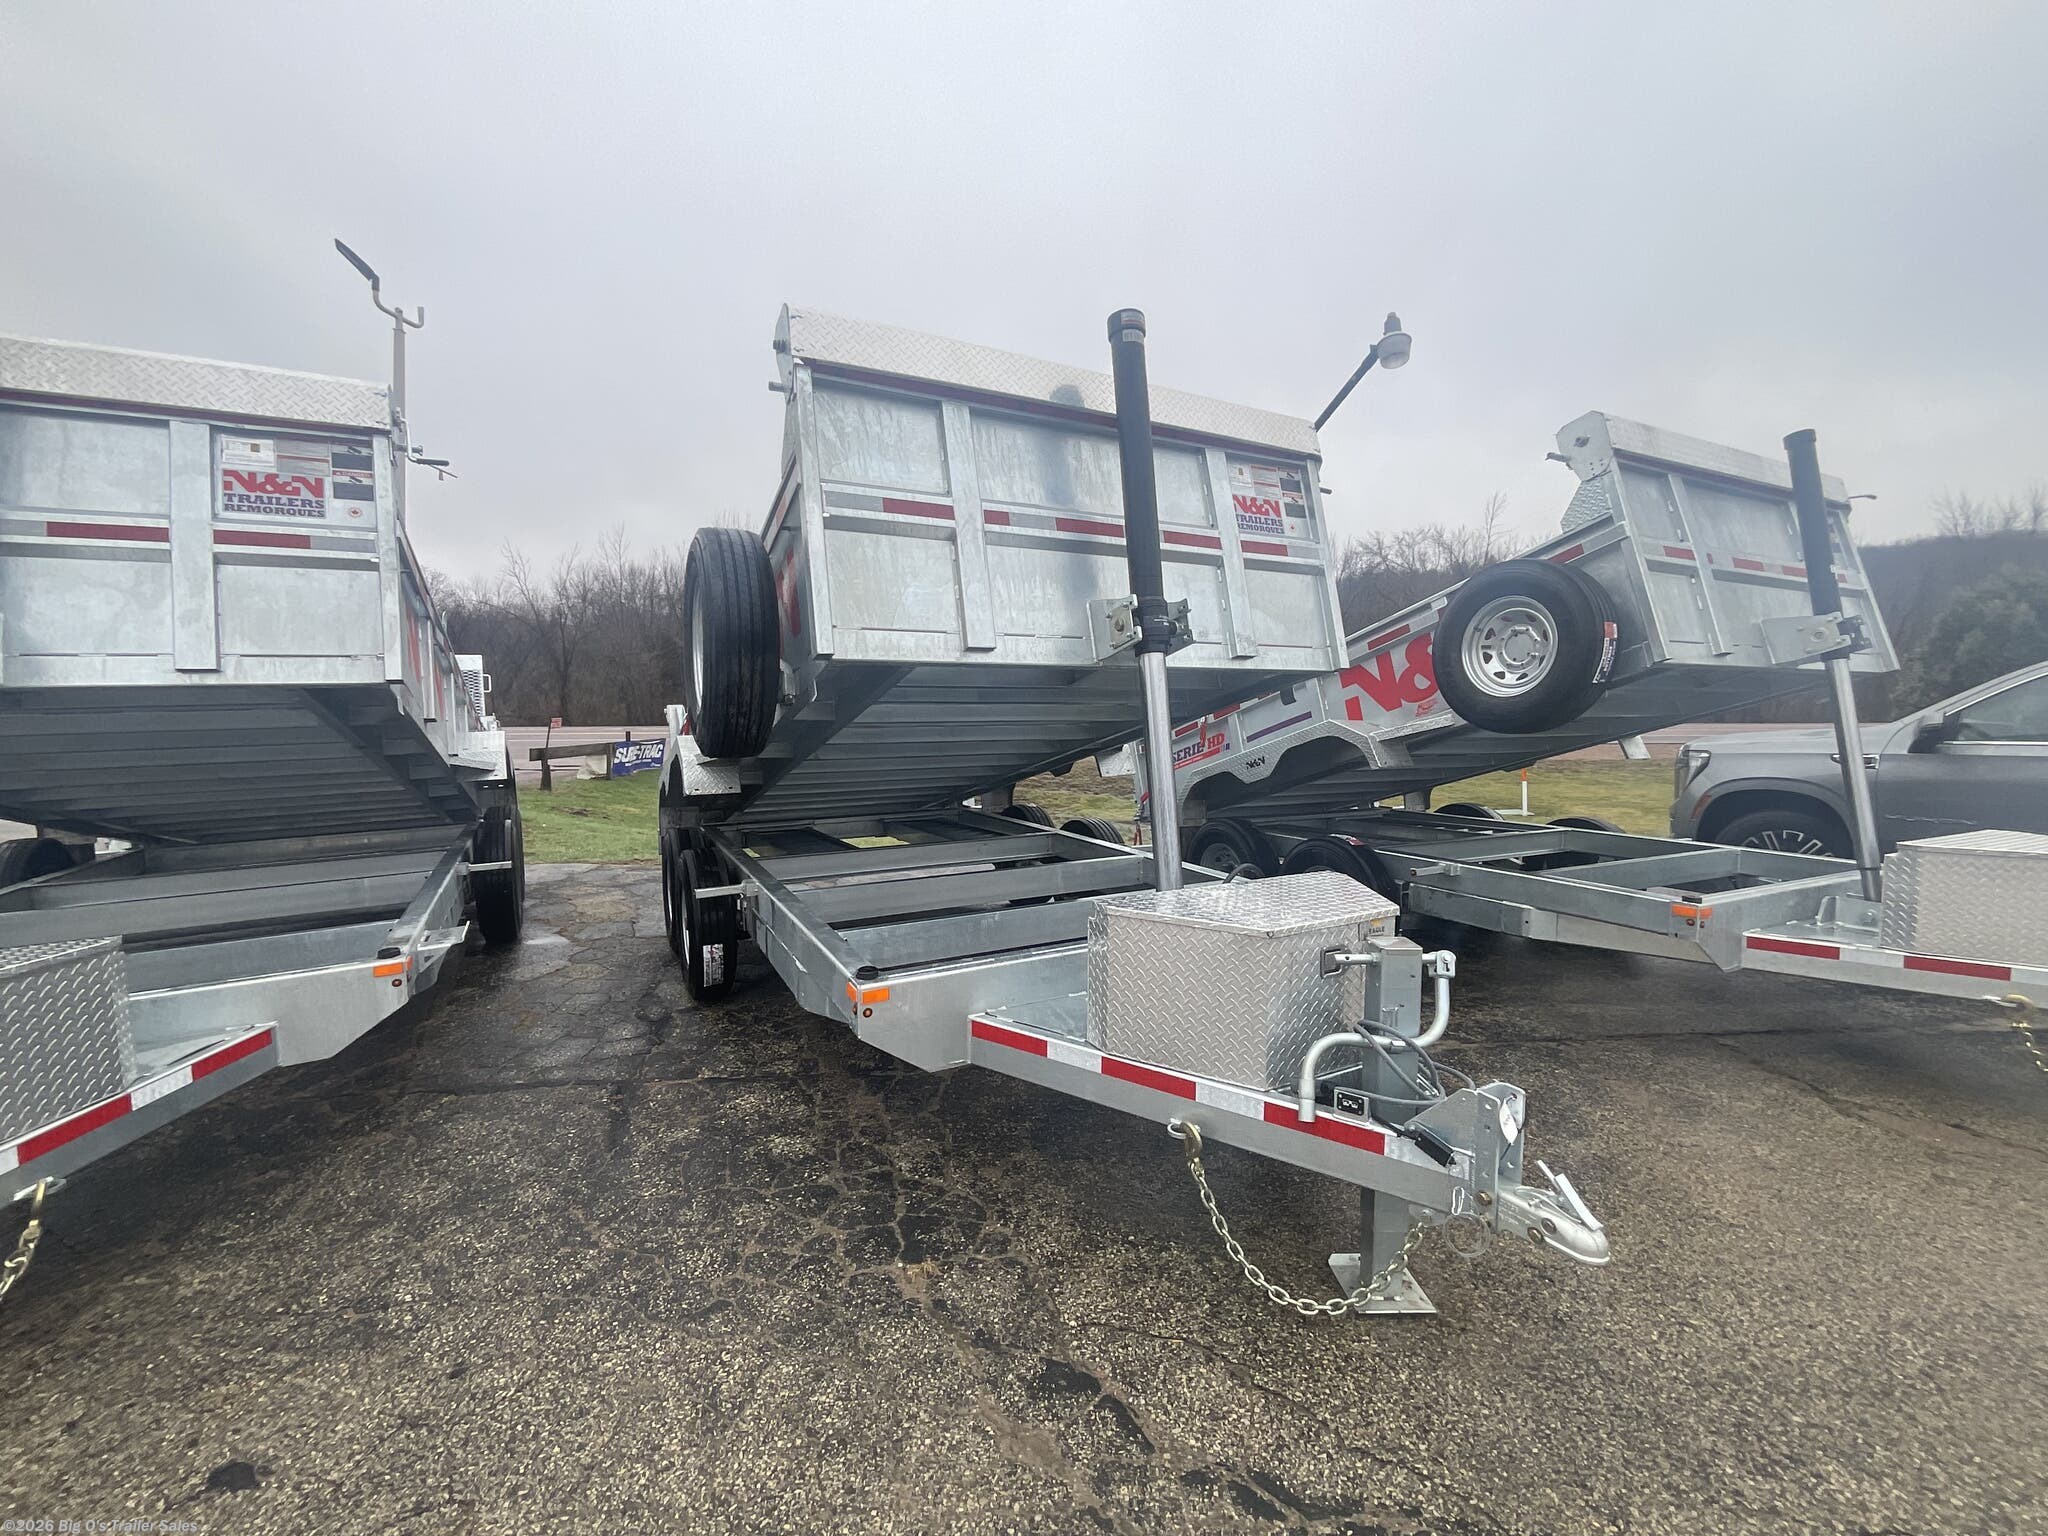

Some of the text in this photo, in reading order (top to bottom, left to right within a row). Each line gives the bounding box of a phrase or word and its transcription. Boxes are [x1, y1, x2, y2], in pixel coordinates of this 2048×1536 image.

[223, 469, 325, 498] N&N
[224, 492, 325, 509] TRAILERS
[1232, 494, 1282, 518] N&N
[224, 503, 325, 517] REMORQUES
[1207, 732, 1225, 749] HD
